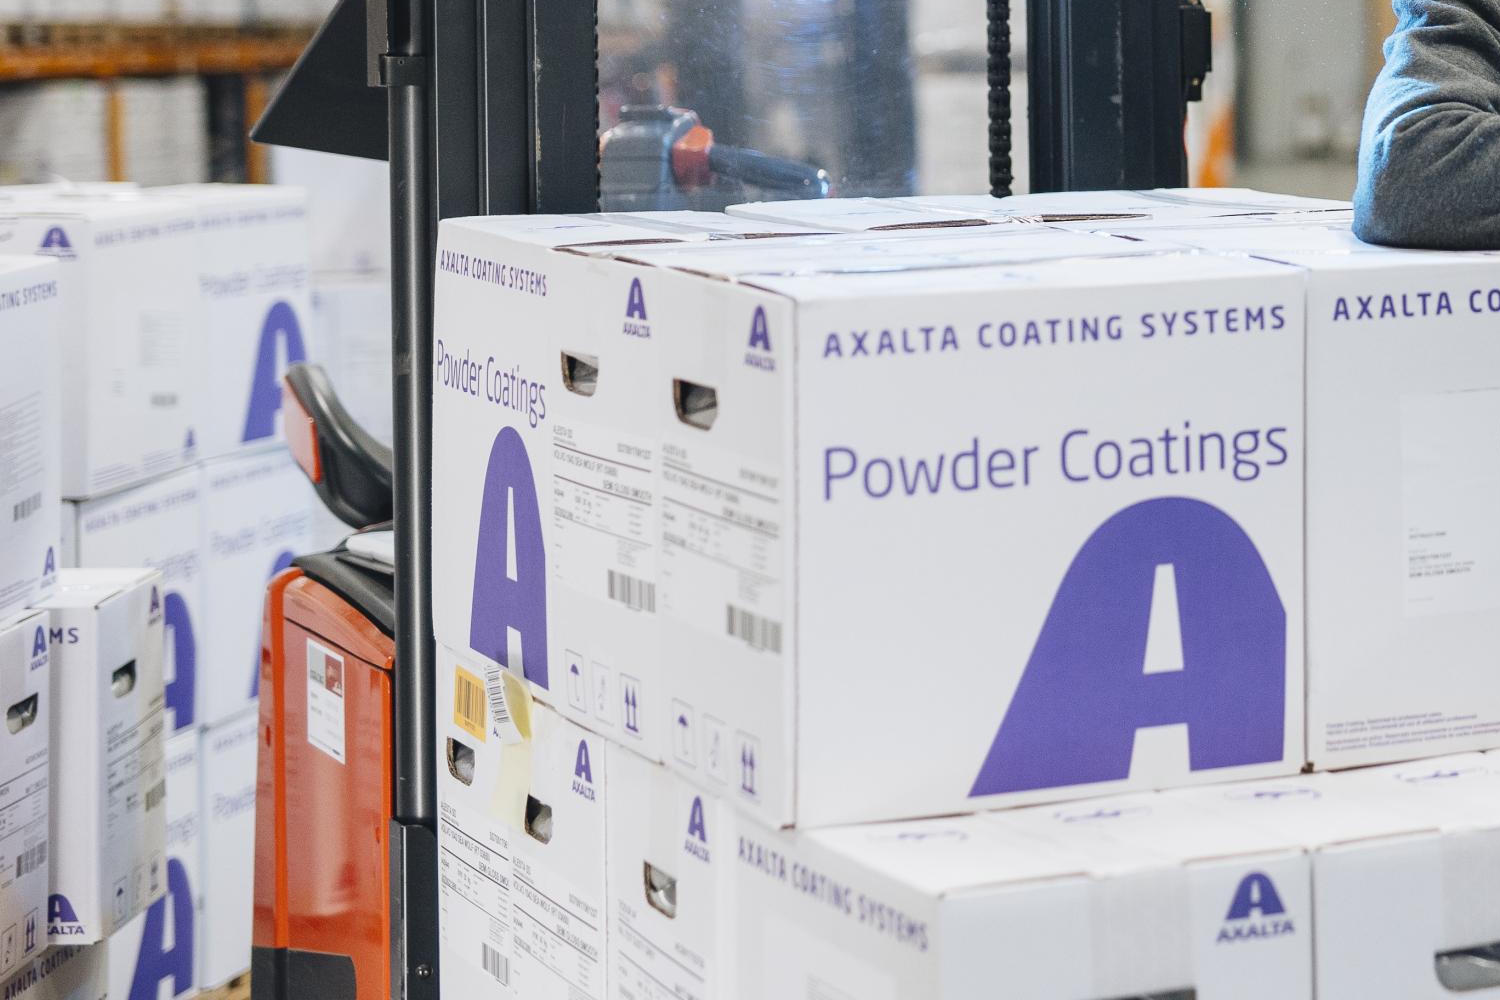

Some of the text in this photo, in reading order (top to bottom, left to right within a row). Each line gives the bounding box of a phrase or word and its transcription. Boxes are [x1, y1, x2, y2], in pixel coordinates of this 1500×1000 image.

[440, 249, 547, 297] AXALTA COATING SYSTEMS
[823, 305, 1286, 359] AXALTA COATING SYSTEMS
[1333, 292, 1453, 322] AXALTA
[437, 339, 546, 429] Powder Coatings
[824, 421, 1289, 501] Powder Coatings
[572, 780, 596, 802] AXALTA
[738, 836, 929, 953] AXALTA COATING SYSTEMS
[1216, 919, 1296, 945] AXALTA
